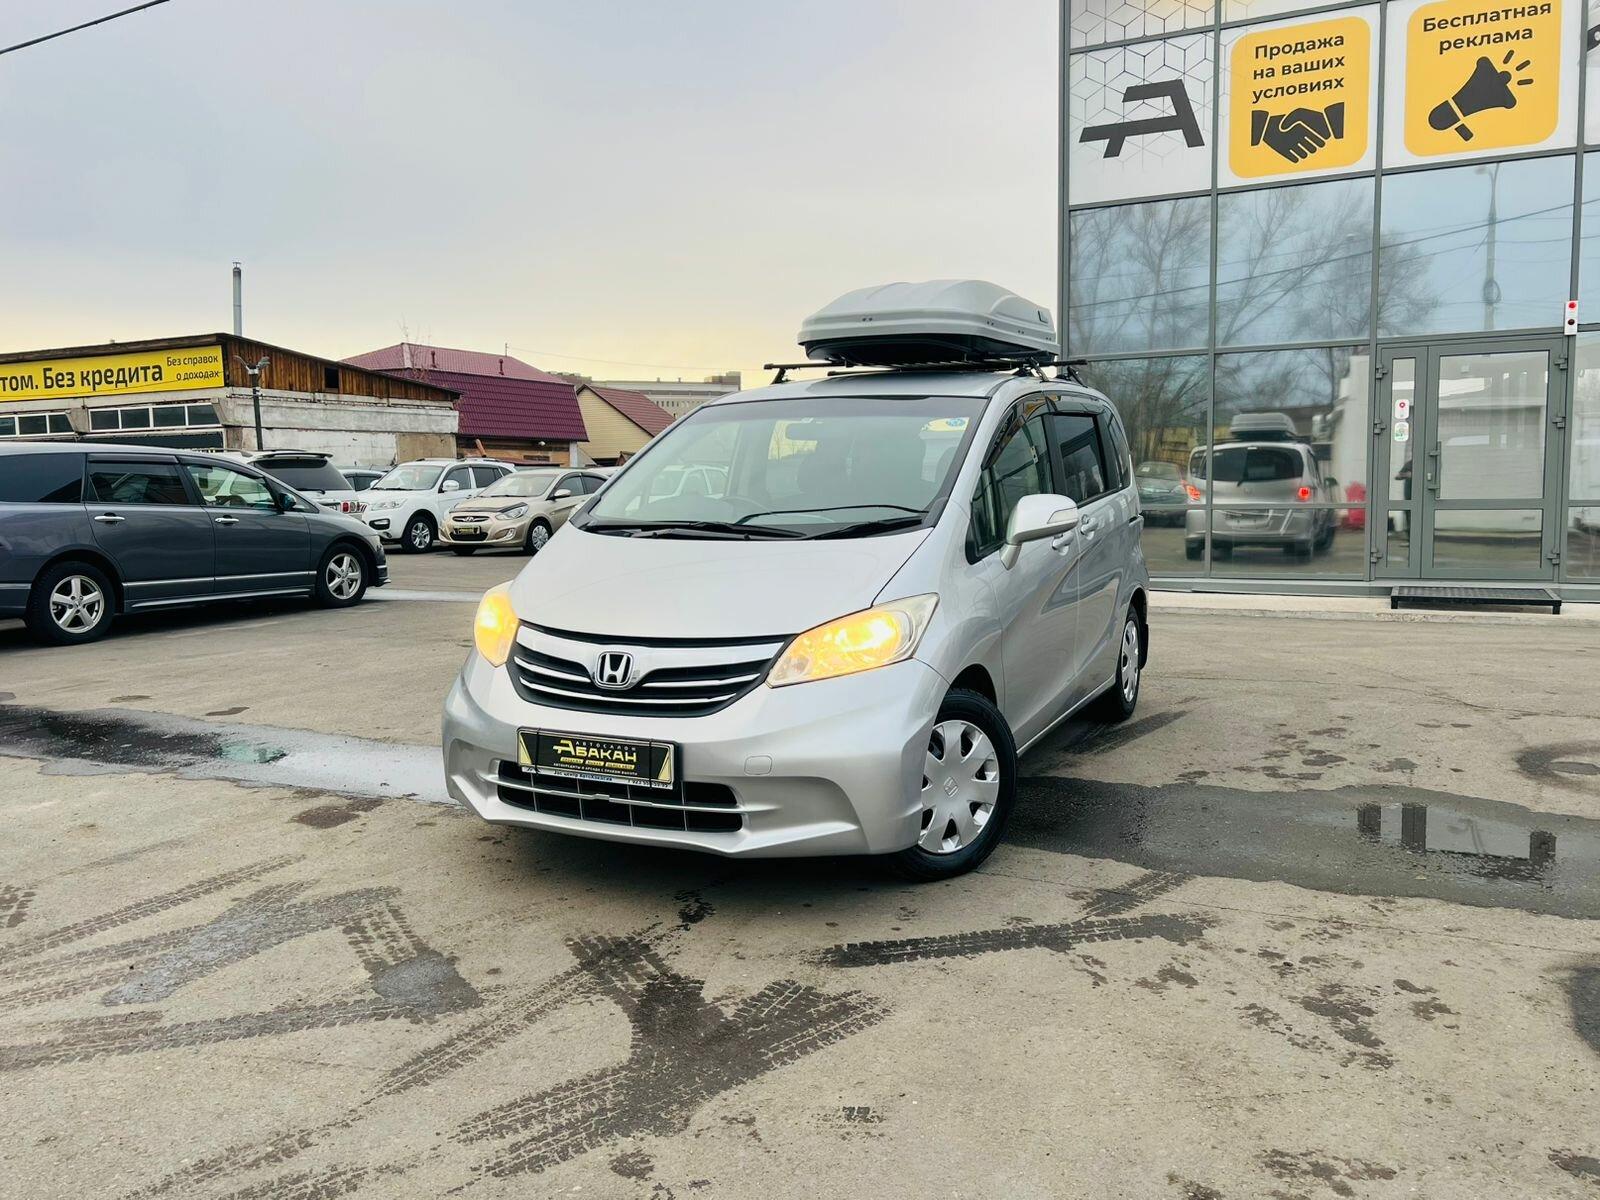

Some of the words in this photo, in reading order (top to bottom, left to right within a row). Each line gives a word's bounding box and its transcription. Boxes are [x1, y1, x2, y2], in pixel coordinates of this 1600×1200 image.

[1423, 3, 1551, 32] Бесплатная
[1255, 35, 1344, 60] Продажа
[1439, 28, 1533, 55] реклама
[1253, 67, 1275, 80] на
[1281, 56, 1345, 76] ваших
[1252, 77, 1345, 104] условиях
[166, 356, 182, 366] Без
[183, 355, 218, 366] справок
[43, 367, 75, 389] Без
[81, 364, 163, 391] кредита
[176, 372, 182, 381] о
[183, 370, 219, 381] доходах
[553, 739, 637, 763] АБАКАН
[575, 741, 636, 751] АВТОСАЛОН
